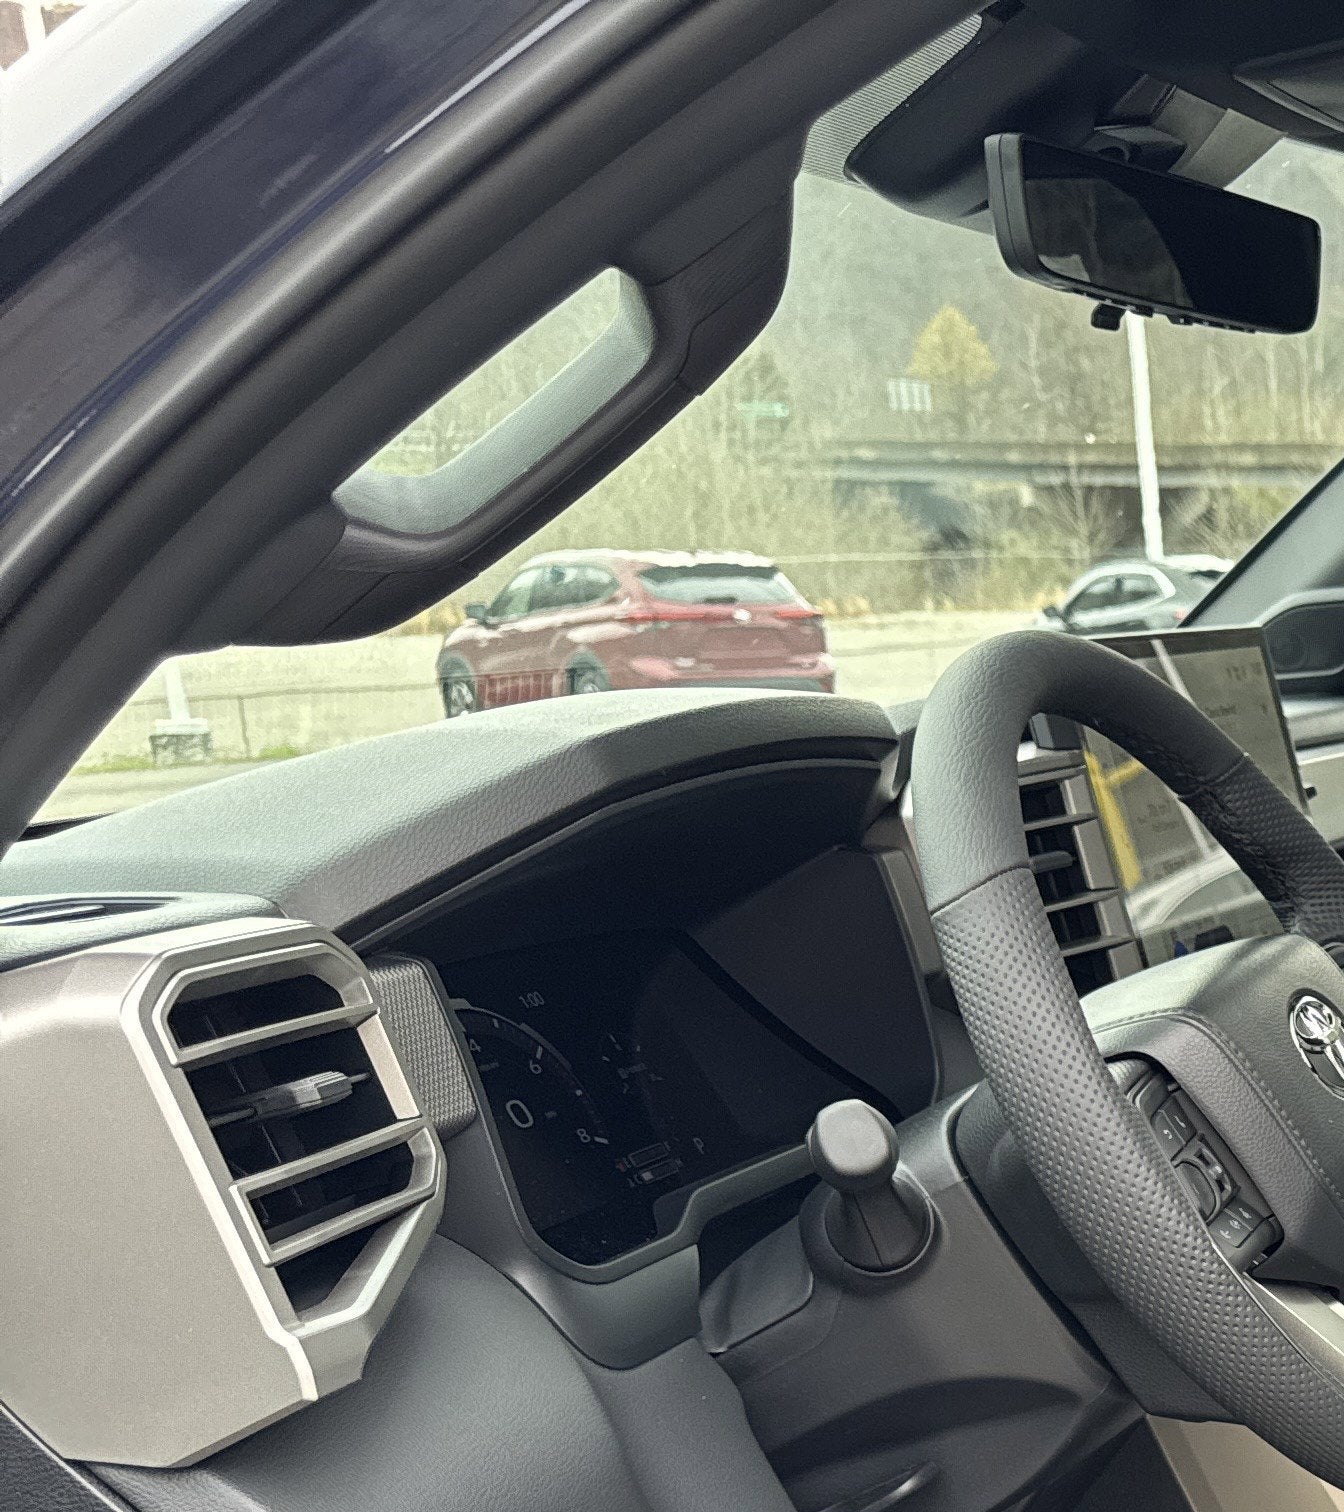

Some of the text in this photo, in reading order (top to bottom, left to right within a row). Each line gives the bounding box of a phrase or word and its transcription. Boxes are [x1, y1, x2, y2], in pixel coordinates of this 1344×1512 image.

[529, 1058, 543, 1075] 6
[505, 1099, 535, 1129] 0
[576, 1127, 592, 1143] 8
